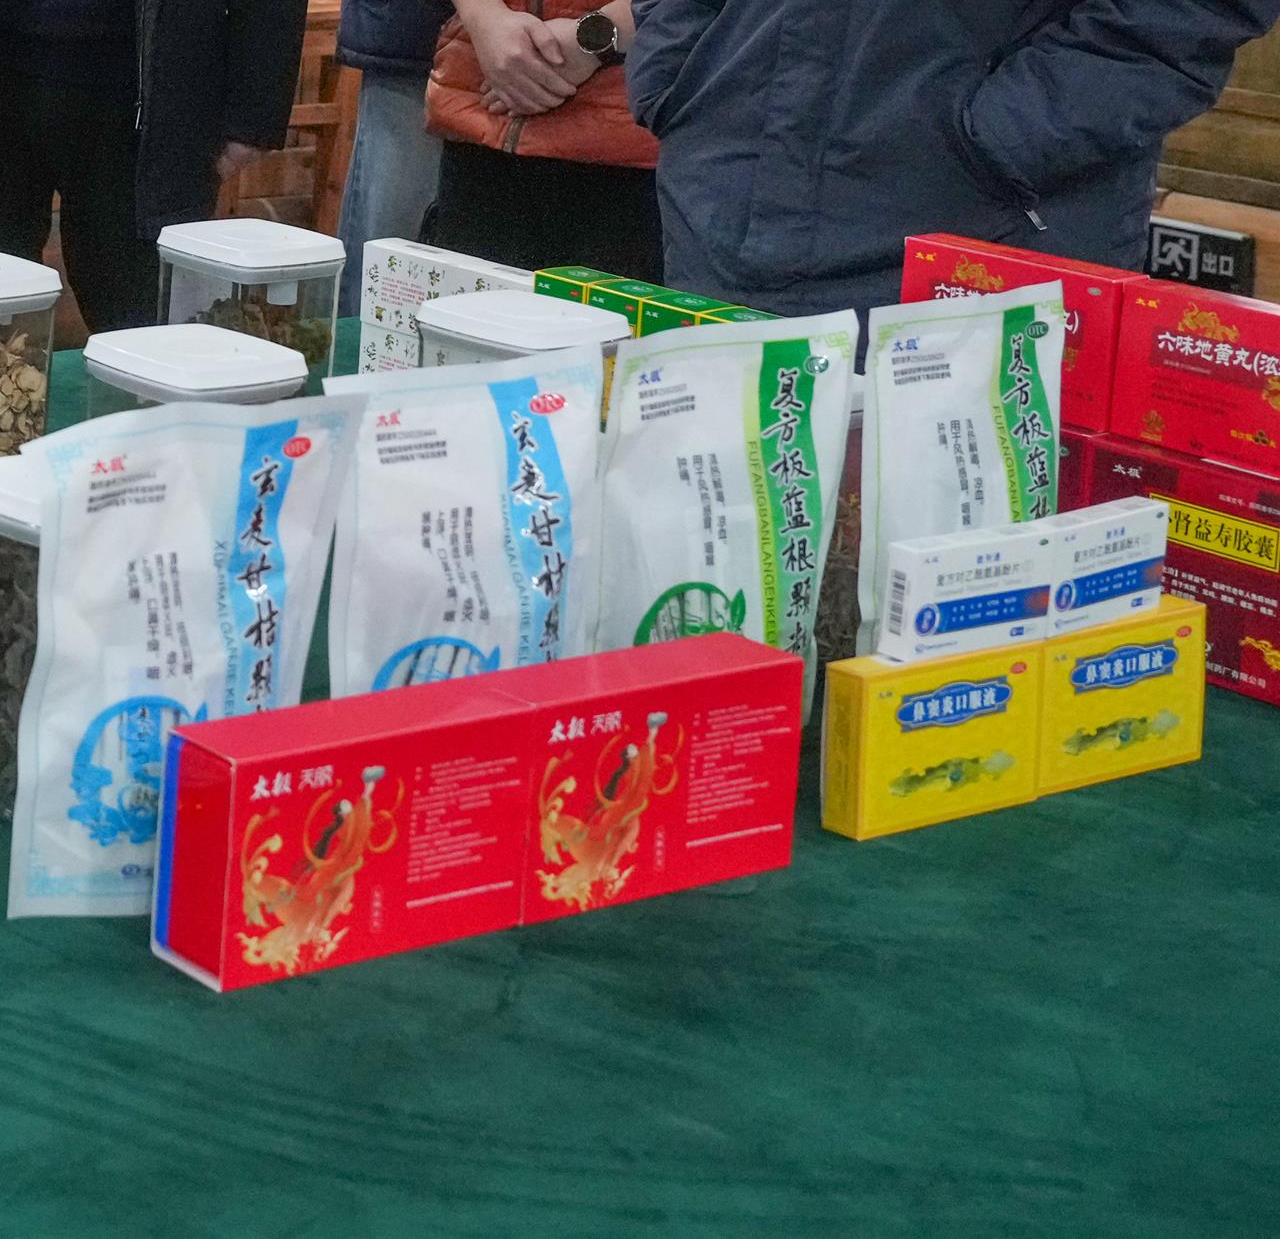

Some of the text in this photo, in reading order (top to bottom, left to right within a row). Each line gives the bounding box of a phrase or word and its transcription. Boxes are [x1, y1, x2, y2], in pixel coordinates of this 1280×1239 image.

[1200, 251, 1235, 277] 出口
[1167, 510, 1275, 561] 肾益寿胶囊
